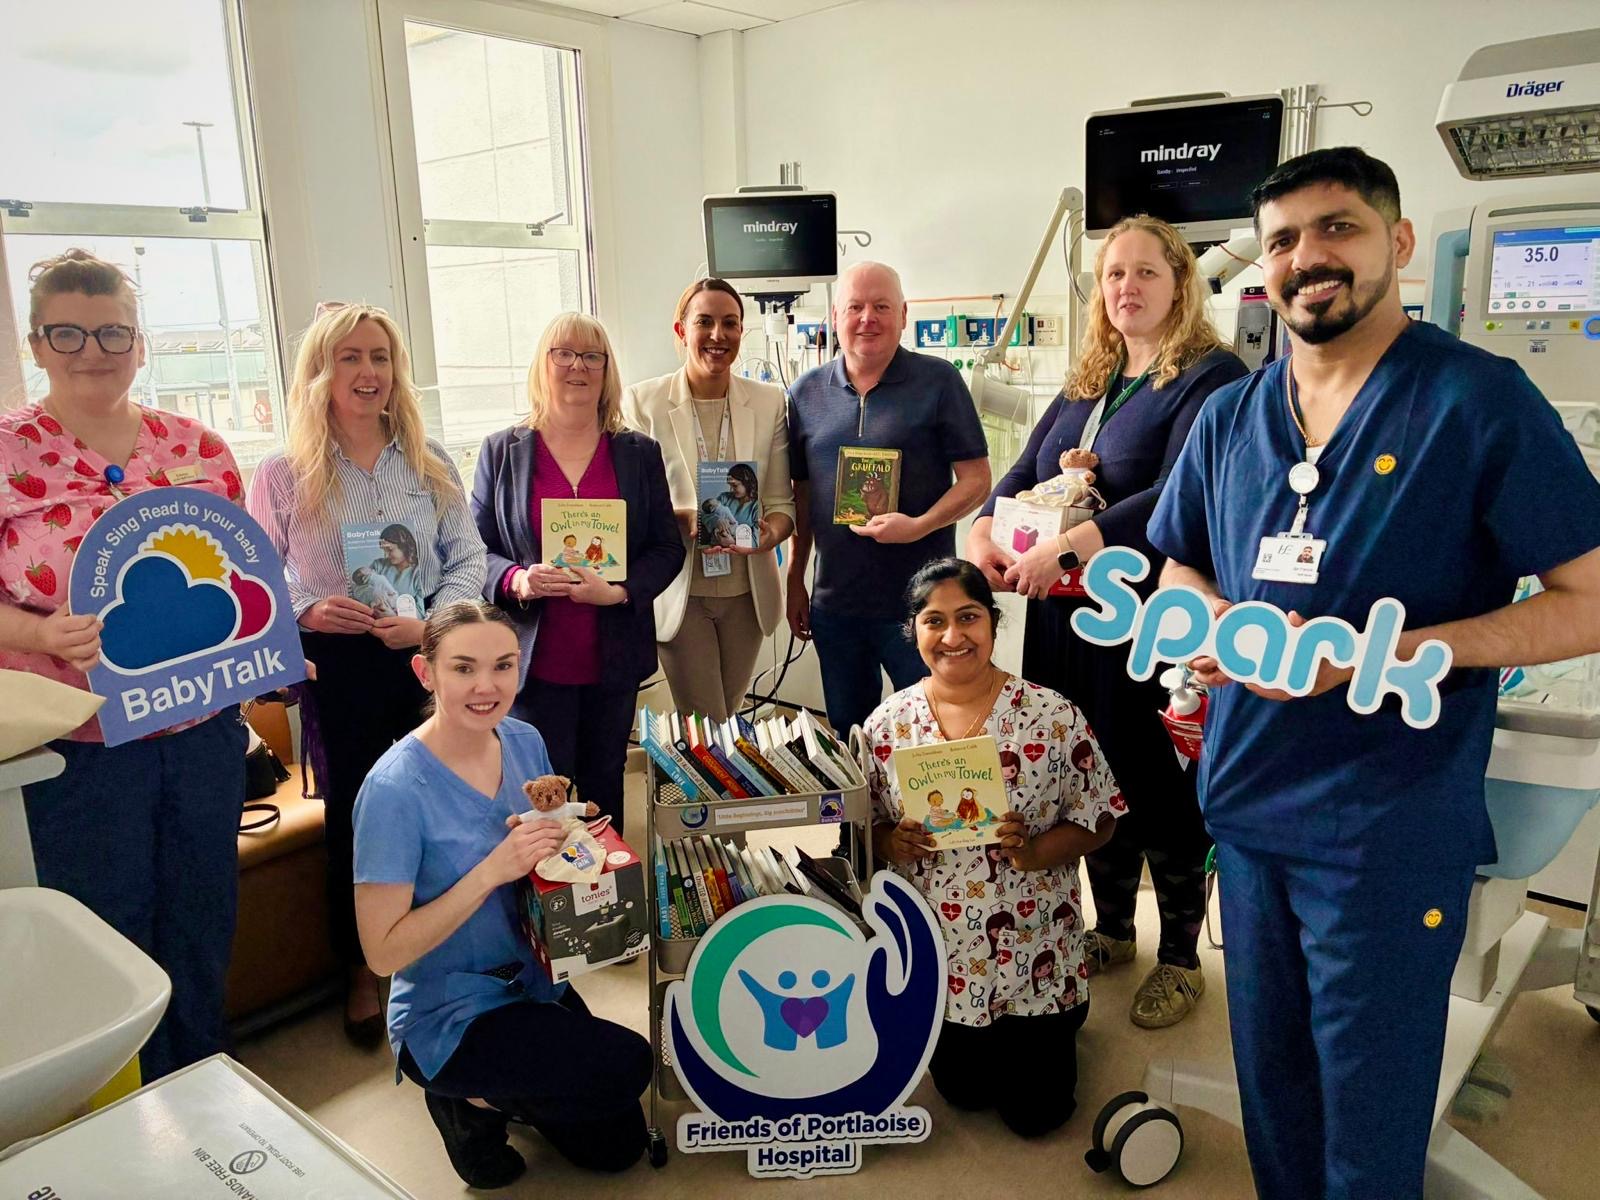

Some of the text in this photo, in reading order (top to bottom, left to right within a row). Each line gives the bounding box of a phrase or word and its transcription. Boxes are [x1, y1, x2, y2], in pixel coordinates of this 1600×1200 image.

[1505, 79, 1565, 98] Dräger
[1140, 142, 1222, 163] mindray
[743, 220, 798, 235] mindray
[1523, 246, 1559, 263] 35.0
[561, 510, 588, 520] There's
[550, 520, 572, 533] Owl
[591, 518, 620, 534] Towel
[346, 530, 381, 539] BabyTalk
[90, 501, 261, 599] Speak Sing Read to your baby
[918, 757, 967, 772] There's an
[908, 765, 993, 791] Owl in my Towel
[686, 1112, 921, 1142] Friends of Portlaoise
[192, 1147, 211, 1163] BIN
[265, 1143, 283, 1158] PEDAL
[757, 1143, 850, 1168] Hospital
[204, 1159, 231, 1181] FREE
[278, 1156, 296, 1169] FOOT
[292, 1167, 306, 1178] USE
